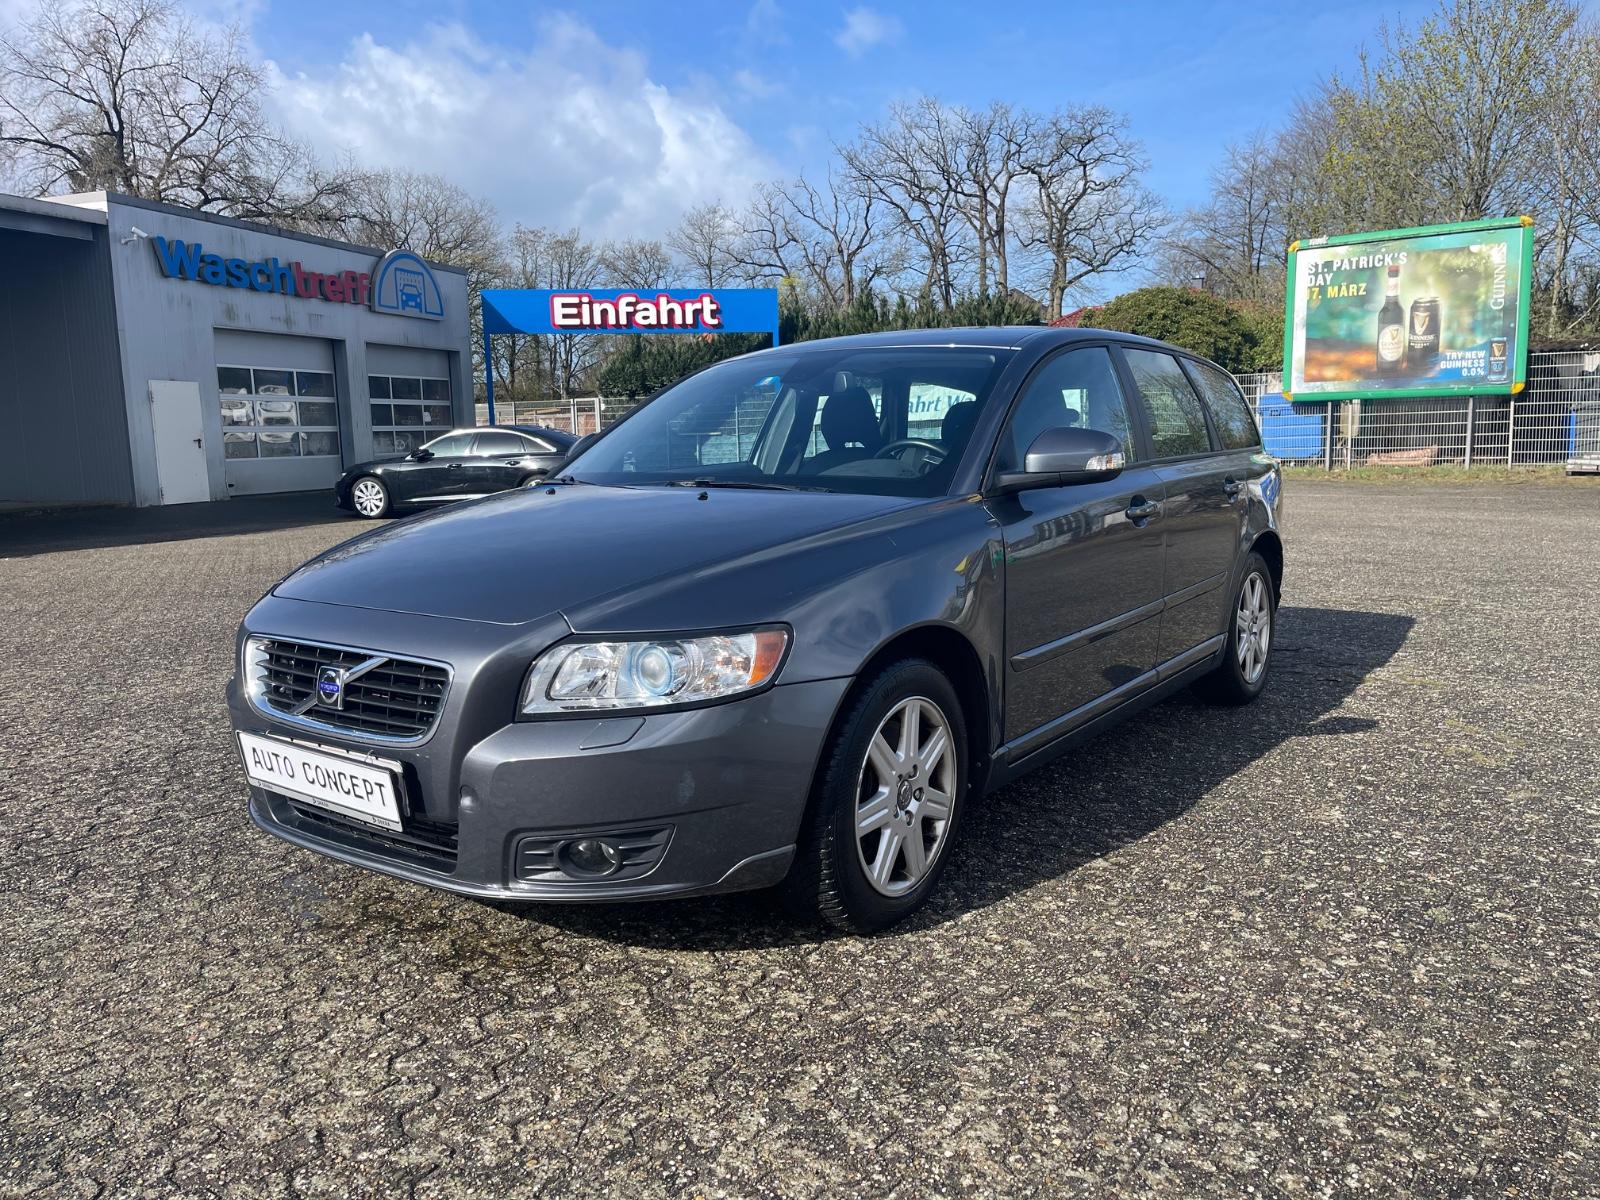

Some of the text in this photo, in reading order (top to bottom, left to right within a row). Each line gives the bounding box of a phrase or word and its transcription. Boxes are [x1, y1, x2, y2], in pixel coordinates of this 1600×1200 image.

[153, 236, 370, 305] Waschtreff
[1308, 252, 1408, 274] ST. PATRICK'S
[1308, 273, 1334, 287] DAY
[1327, 282, 1367, 299] MÄRZ
[551, 293, 721, 329] Einfahrt
[1446, 351, 1463, 360] TRY
[1465, 350, 1486, 360] NEW
[1440, 359, 1485, 369] GUINNESS
[1462, 368, 1485, 377] 0.0%
[252, 746, 386, 807] AUTO CONCEPT
